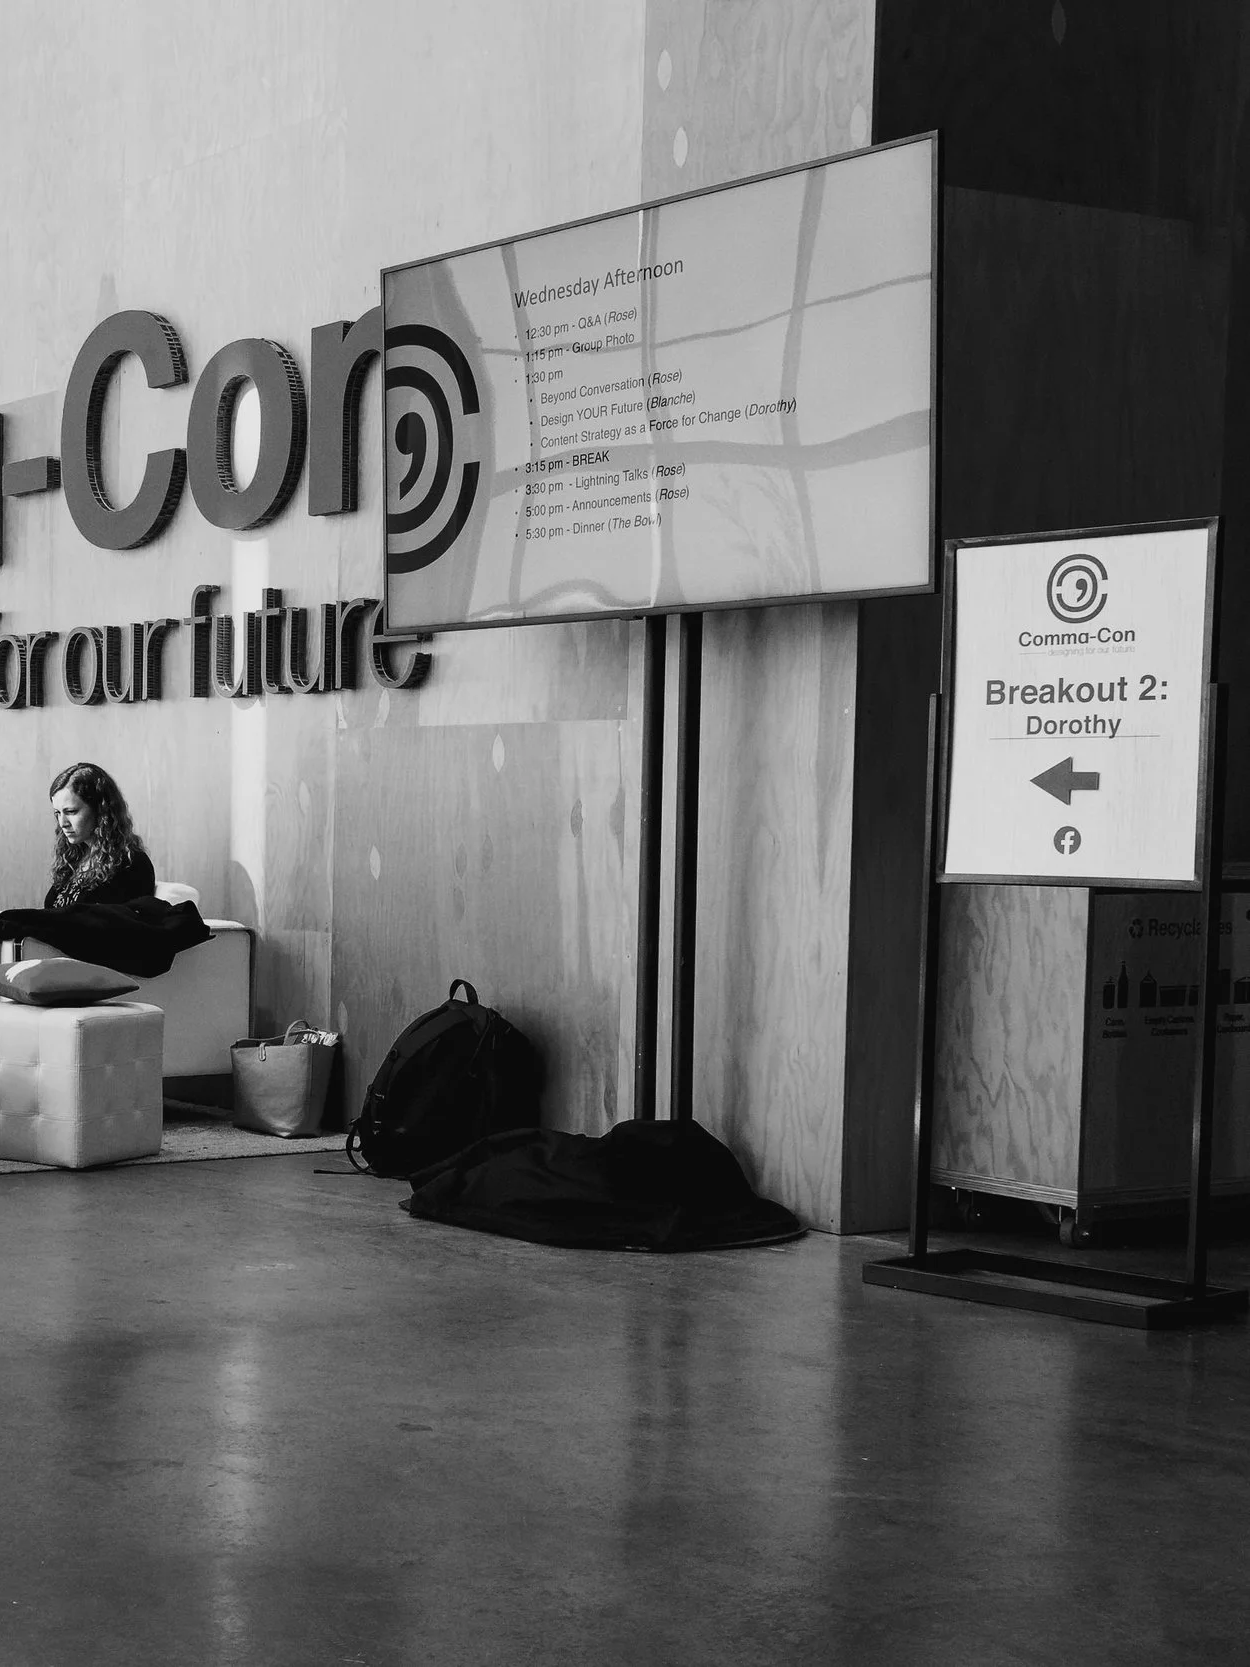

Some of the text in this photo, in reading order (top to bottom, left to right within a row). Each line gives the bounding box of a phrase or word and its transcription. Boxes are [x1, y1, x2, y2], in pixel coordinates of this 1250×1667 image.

[514, 259, 683, 307] Wednesday Afternoon
[525, 324, 551, 339] 12:30
[554, 323, 568, 337] pm
[578, 314, 601, 329] Q&A
[604, 307, 637, 325] (Rose)
[525, 348, 545, 362] 1:15
[548, 345, 563, 360] pm
[572, 338, 602, 353] Group
[605, 332, 634, 346] Photo
[525, 369, 563, 384] 1:30 pm
[540, 369, 682, 405] Beyond Conversation (Rose)
[540, 390, 695, 427] Design YOUR Future (Blanche)
[540, 397, 796, 448] Content Strategy as a Force for Change (Dorothy)
[525, 460, 545, 473] 3:15
[548, 458, 563, 471] pm
[572, 450, 609, 466] BREAK
[525, 482, 545, 494] 3:30
[548, 481, 563, 493] pm
[575, 472, 619, 489] Lightning
[623, 468, 647, 481] Talks
[651, 462, 685, 478] (Rose)
[525, 504, 545, 517] 5:00
[548, 503, 563, 516] pm
[572, 491, 651, 511] Announcements
[655, 485, 689, 501] (Rose)
[525, 527, 545, 539] 5:30
[548, 525, 563, 539] pm
[573, 521, 604, 534] Dinner
[607, 517, 630, 531] (The
[1018, 627, 1136, 648] Comma-Con
[62, 618, 179, 706] our
[986, 675, 1169, 706] Breakout 2:
[1026, 714, 1121, 739] Dorothy
